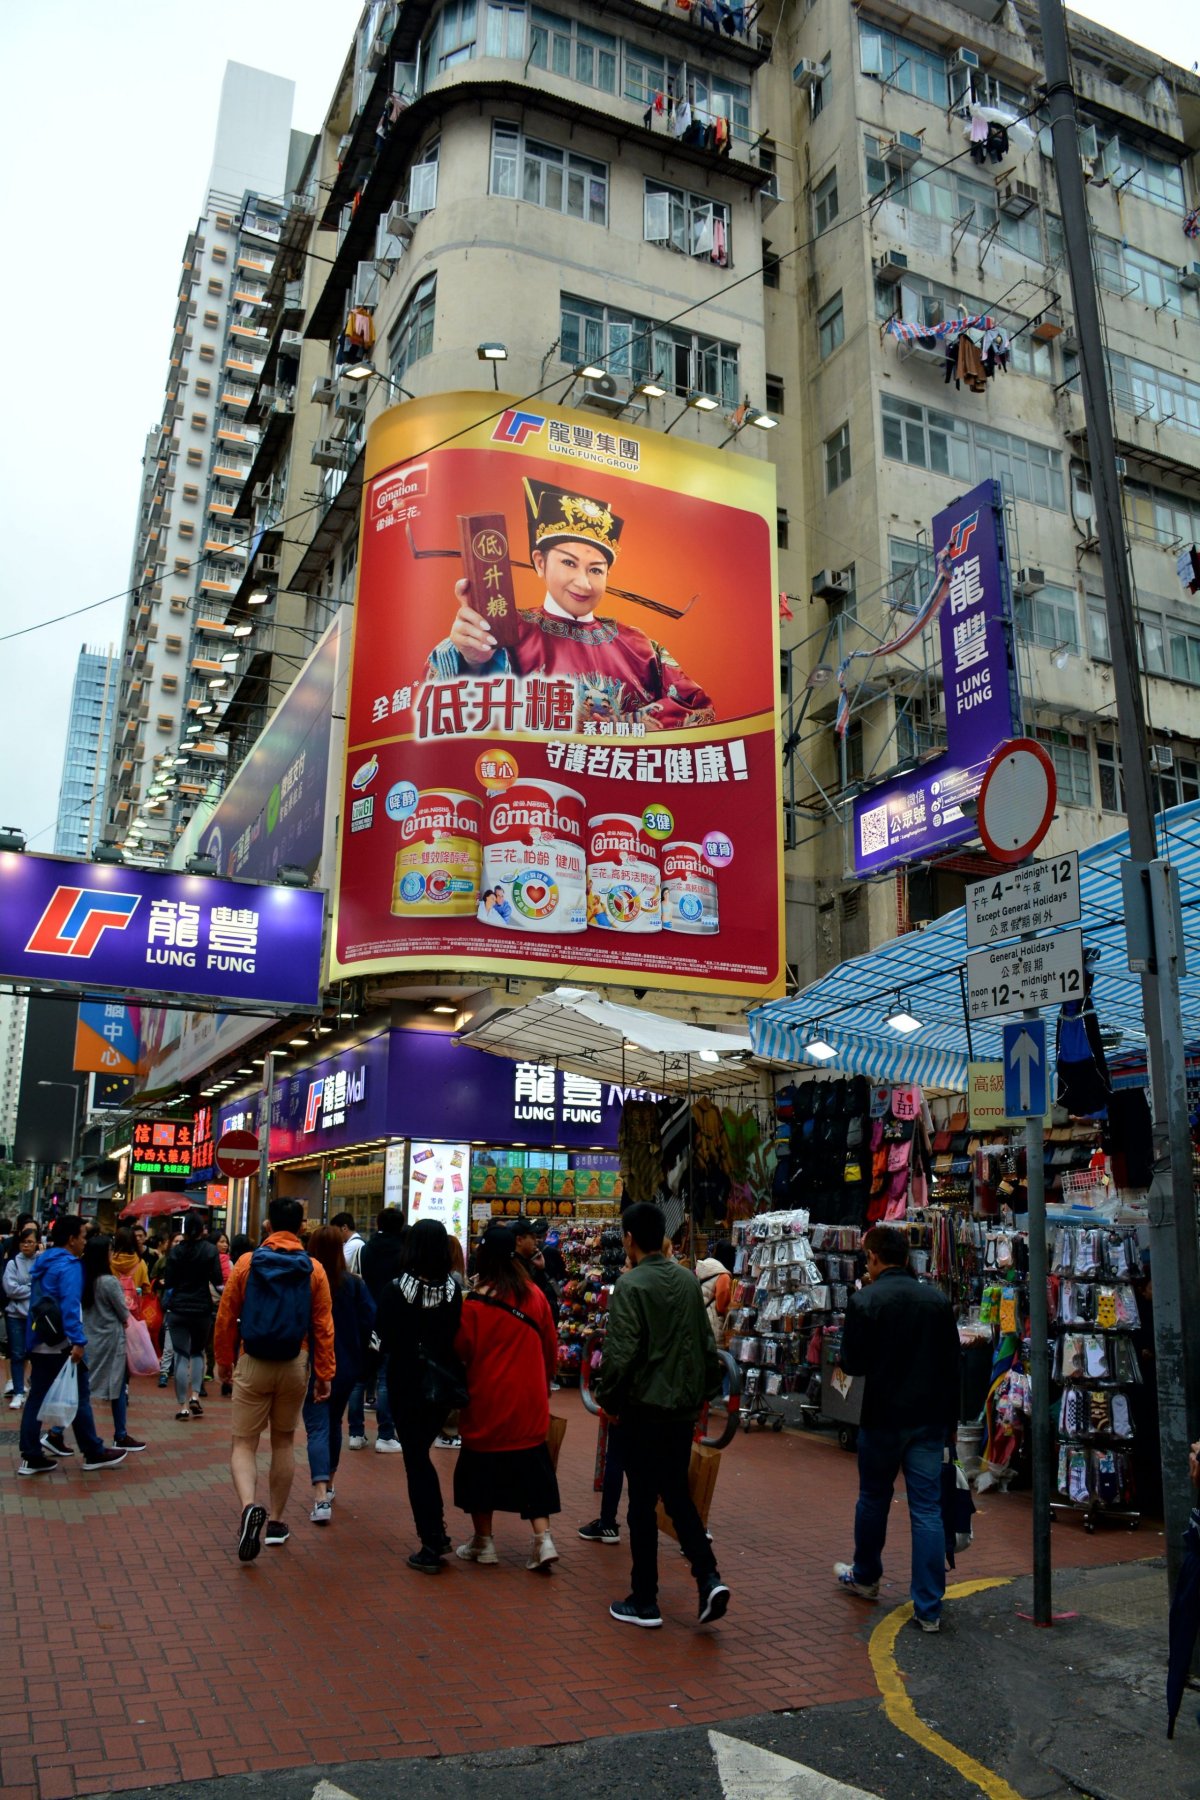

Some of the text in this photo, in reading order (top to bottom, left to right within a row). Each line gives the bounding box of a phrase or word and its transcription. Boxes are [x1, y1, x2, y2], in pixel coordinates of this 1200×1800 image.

[549, 421, 639, 461] 龍豐集團
[549, 444, 640, 472] LUNG FUNG GROUP
[376, 483, 418, 509] Carnation
[477, 534, 509, 618] 低升糖
[948, 555, 990, 674] 龍豐
[956, 668, 991, 698] LUNG
[415, 678, 577, 739] 低升糖
[957, 685, 993, 715] FUNG
[582, 721, 646, 738] 系列奶粉
[480, 761, 514, 780] 護心
[389, 790, 417, 811] 降醇
[401, 812, 478, 841] Carnation
[489, 803, 581, 837] Carnation
[645, 812, 671, 831] 3健
[890, 804, 927, 834] 公眾號
[590, 832, 657, 860] Carnation
[663, 856, 715, 878] Carnation
[974, 885, 985, 896] pm
[1014, 864, 1049, 883] midnight
[1051, 860, 1072, 885] 12
[972, 881, 1042, 911] 下午 午夜
[976, 891, 1068, 924] Except General Holidays
[147, 899, 260, 955] 龍豐
[989, 909, 1054, 937] 公眾假期例外
[146, 948, 256, 974] LUNG FUNG
[989, 941, 1056, 964] General Holidays
[1001, 957, 1044, 979] 公眾假期
[970, 987, 989, 998] noon
[1021, 971, 1057, 987] midnight
[1059, 968, 1080, 993] 12
[971, 988, 1049, 1013] 中午 午夜
[322, 1070, 347, 1114] 龍豐
[346, 1064, 367, 1105] Mall
[514, 1062, 602, 1107] 龍豐
[514, 1105, 602, 1124] LUNG FUNG
[133, 1147, 191, 1165] 中西大藥房
